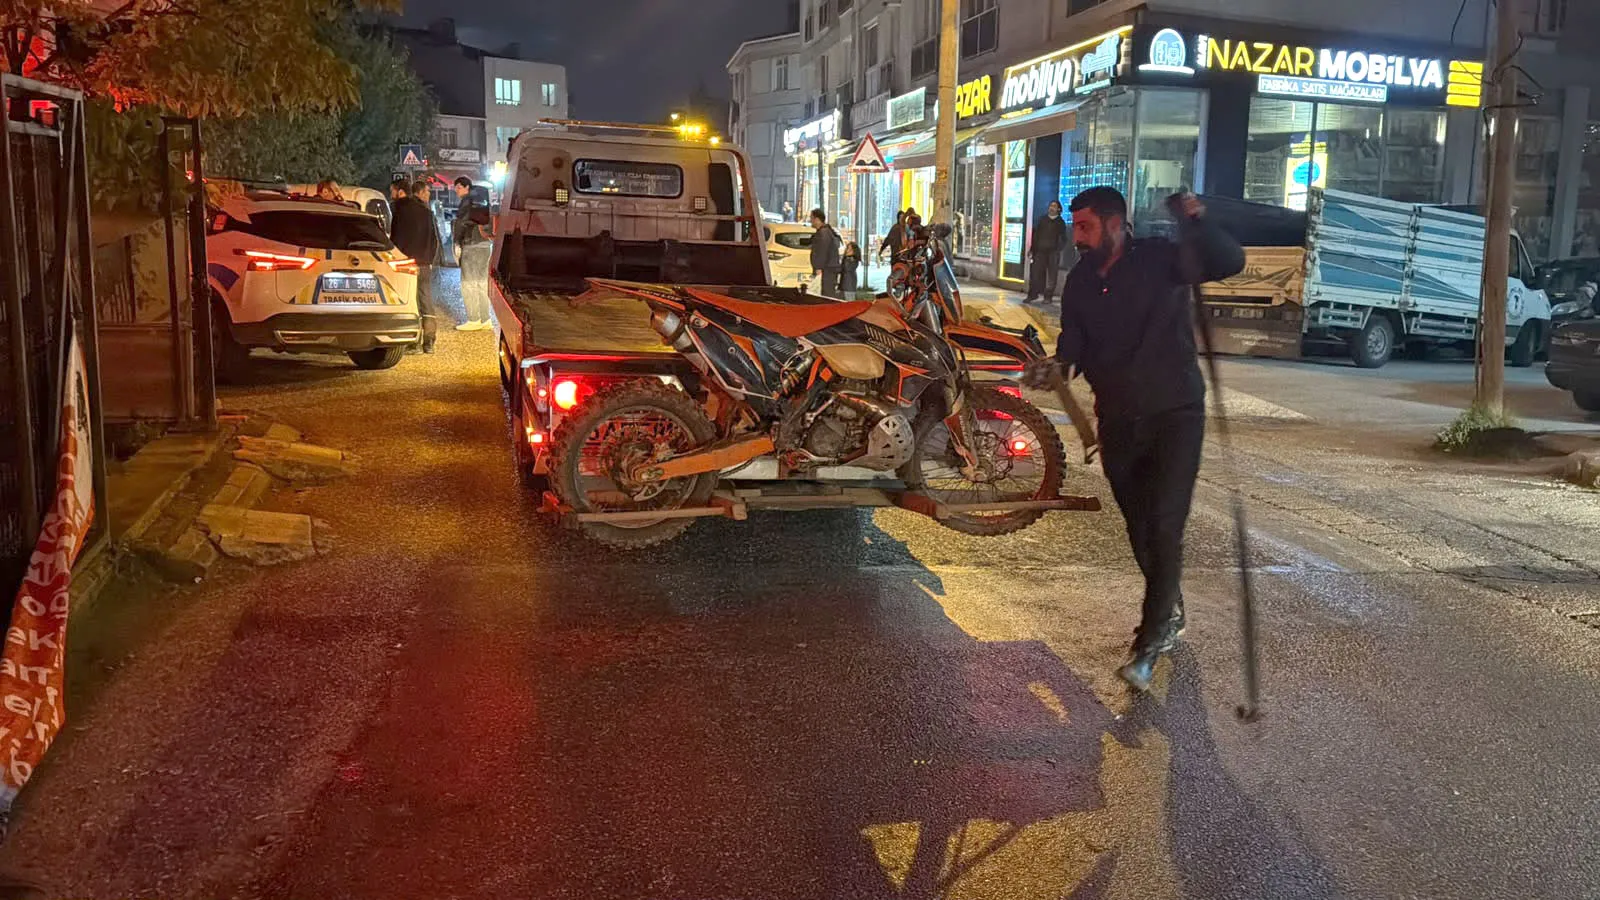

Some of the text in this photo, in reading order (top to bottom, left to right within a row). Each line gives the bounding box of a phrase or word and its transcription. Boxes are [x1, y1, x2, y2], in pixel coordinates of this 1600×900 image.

[1206, 37, 1315, 76] NAZAR
[955, 74, 991, 120] AZAR
[329, 278, 337, 289] 26
[345, 278, 350, 289] A
[324, 295, 350, 303] TRAFİK
